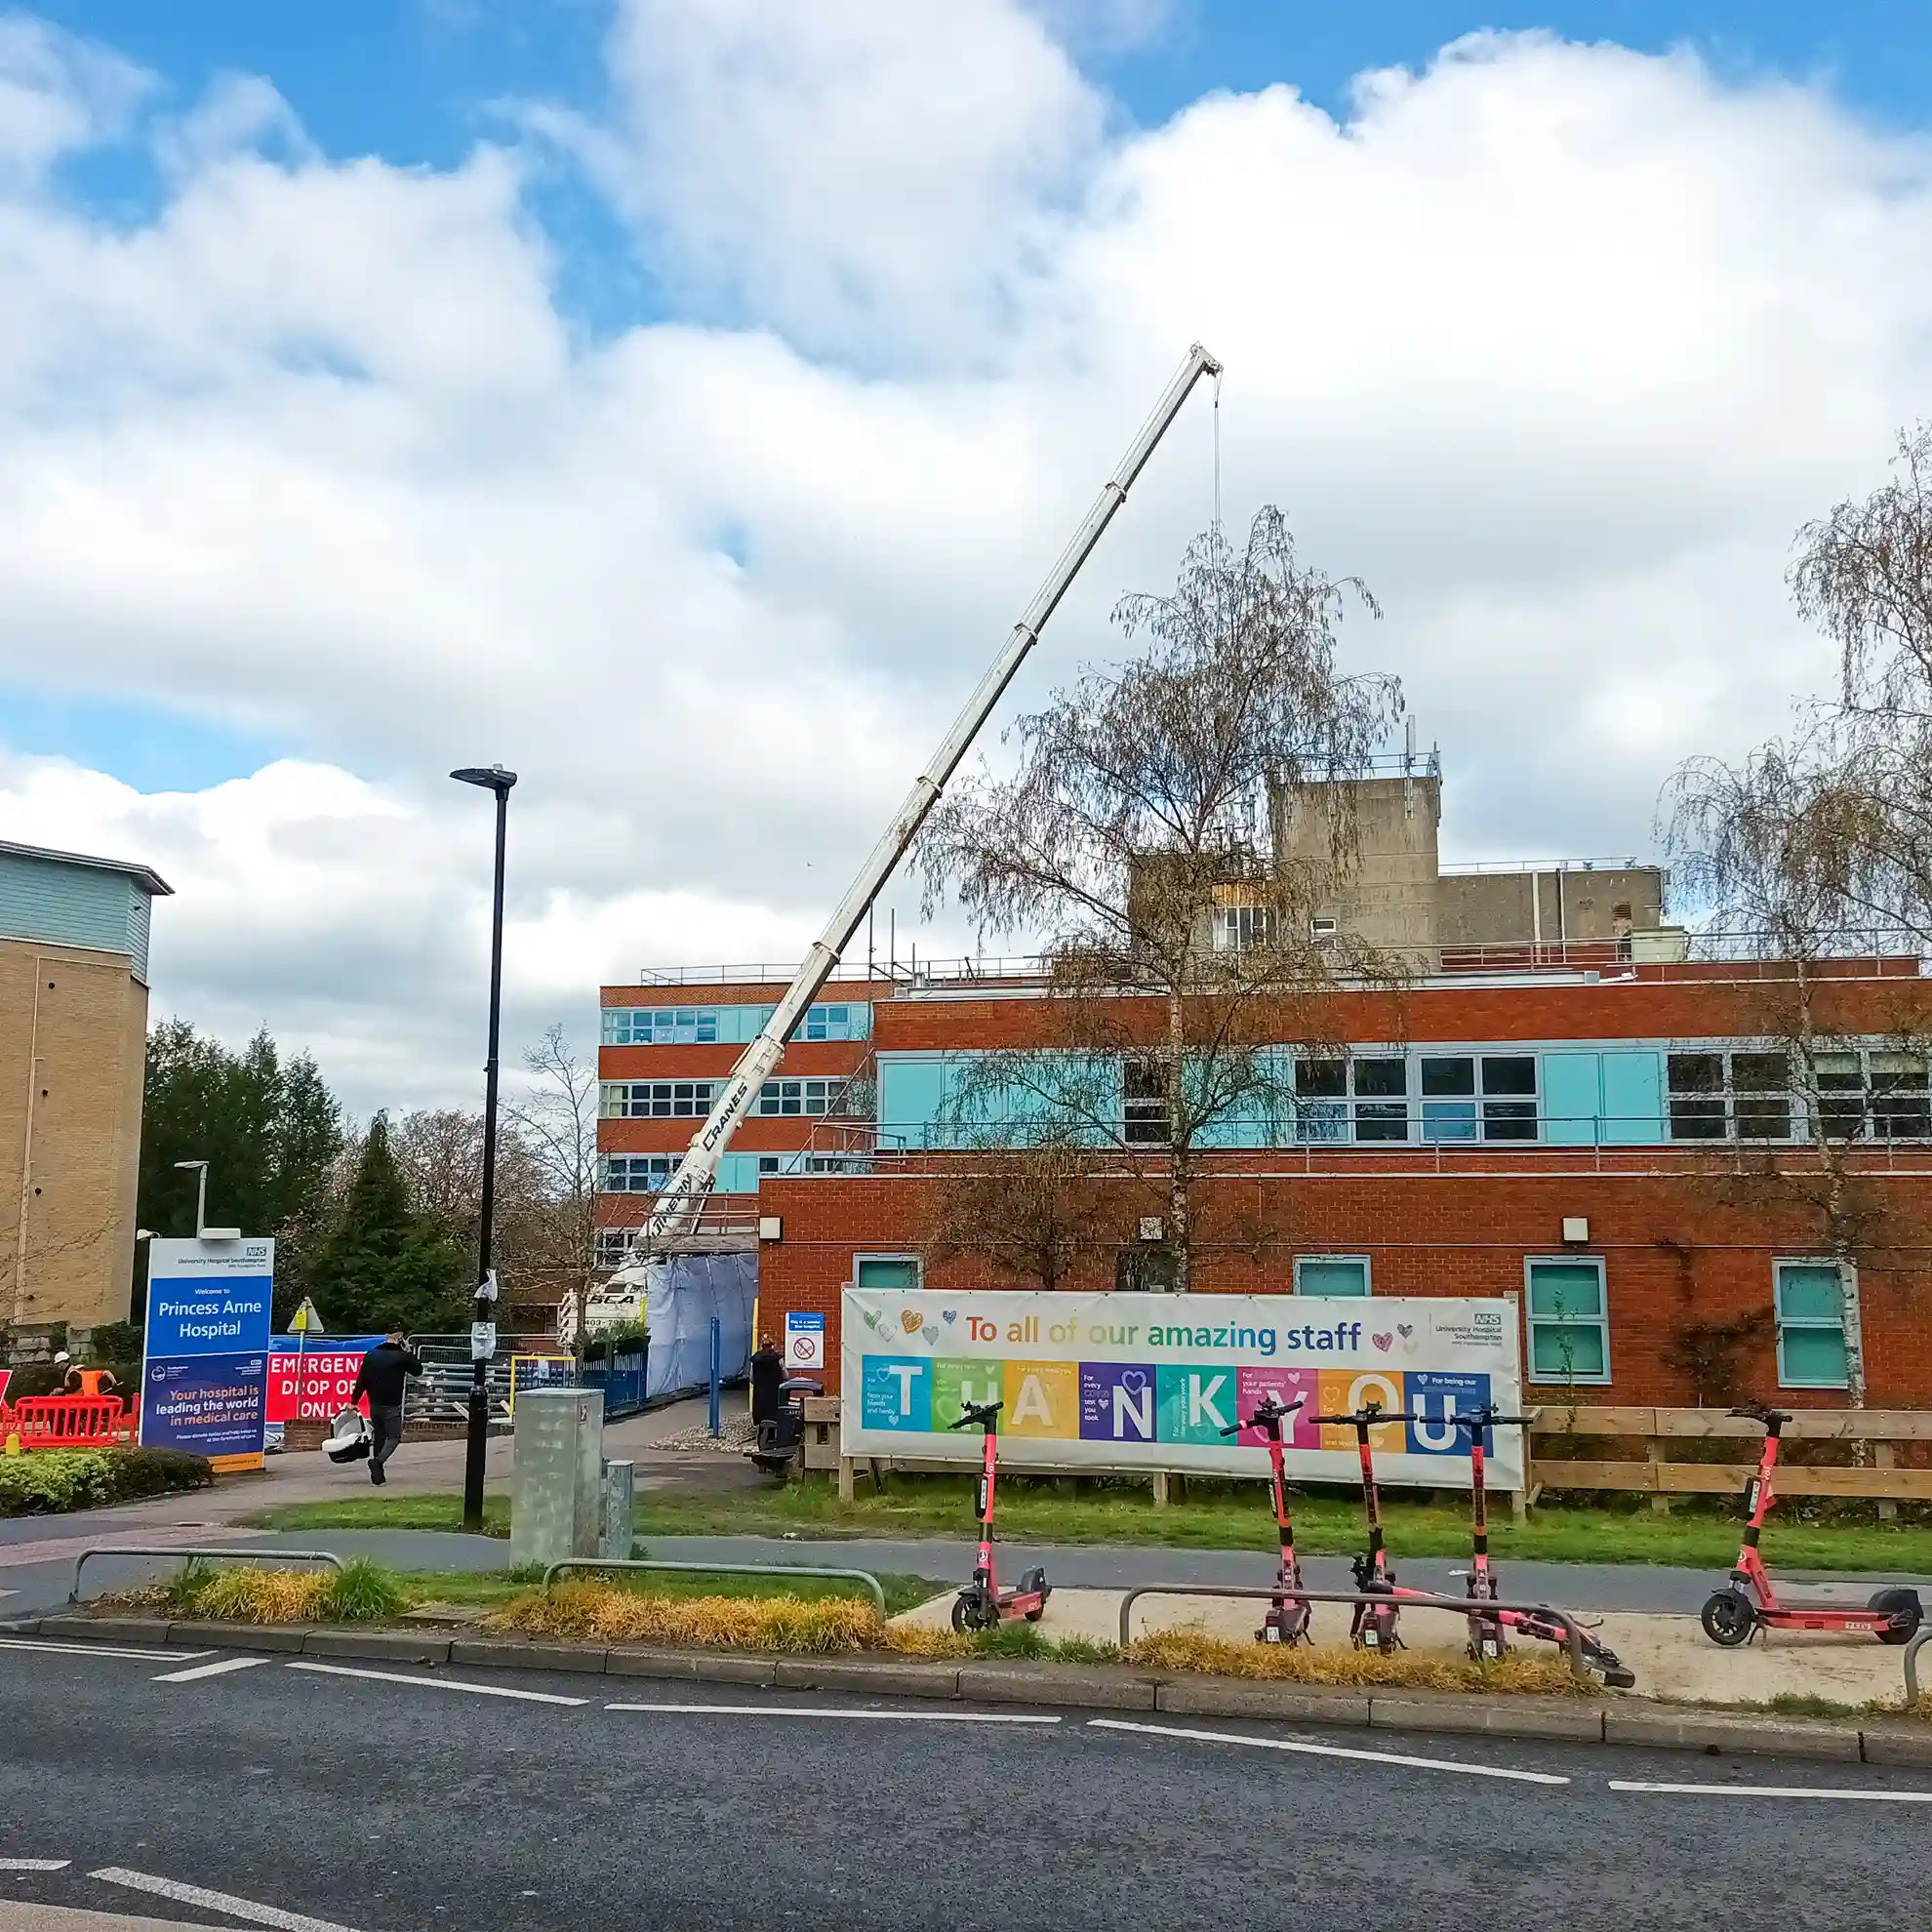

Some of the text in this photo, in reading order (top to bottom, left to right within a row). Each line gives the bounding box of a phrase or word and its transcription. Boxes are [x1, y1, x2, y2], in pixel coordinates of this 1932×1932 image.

[703, 1082, 748, 1151] CRANES
[247, 1247, 267, 1256] NHS
[159, 1300, 262, 1316] Princess Anne
[1474, 1313, 1501, 1325] NHS
[180, 1320, 241, 1340] Hospital
[966, 1315, 1362, 1356] To all of our amazing staff
[271, 1357, 362, 1373] EMERGEN
[281, 1379, 357, 1395] DROP OF
[1444, 1377, 1464, 1386] being
[170, 1385, 259, 1401] Your hospital is
[156, 1396, 259, 1415] leading the world
[301, 1402, 349, 1418] ONLY
[170, 1411, 259, 1427] in medical care
